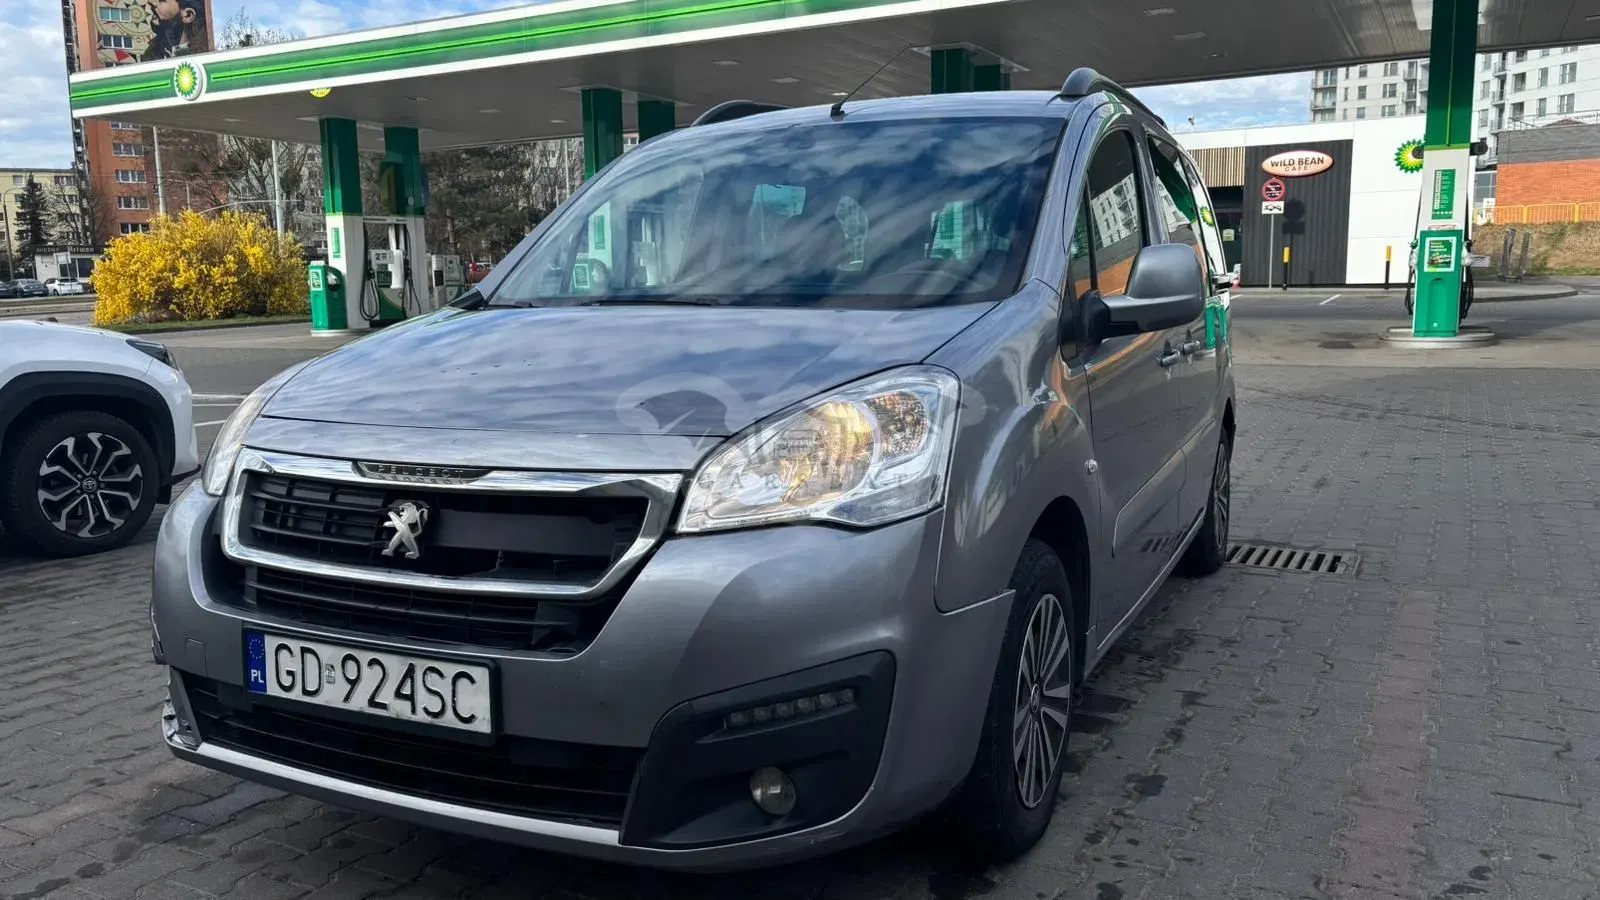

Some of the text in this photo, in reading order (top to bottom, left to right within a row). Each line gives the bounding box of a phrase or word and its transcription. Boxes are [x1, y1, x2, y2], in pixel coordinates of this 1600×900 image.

[1270, 156, 1325, 168] WILD BEAN
[375, 252, 381, 261] 2
[378, 464, 464, 479] PEUGEOT
[251, 669, 264, 684] PL
[274, 642, 477, 724] GD 924SC
